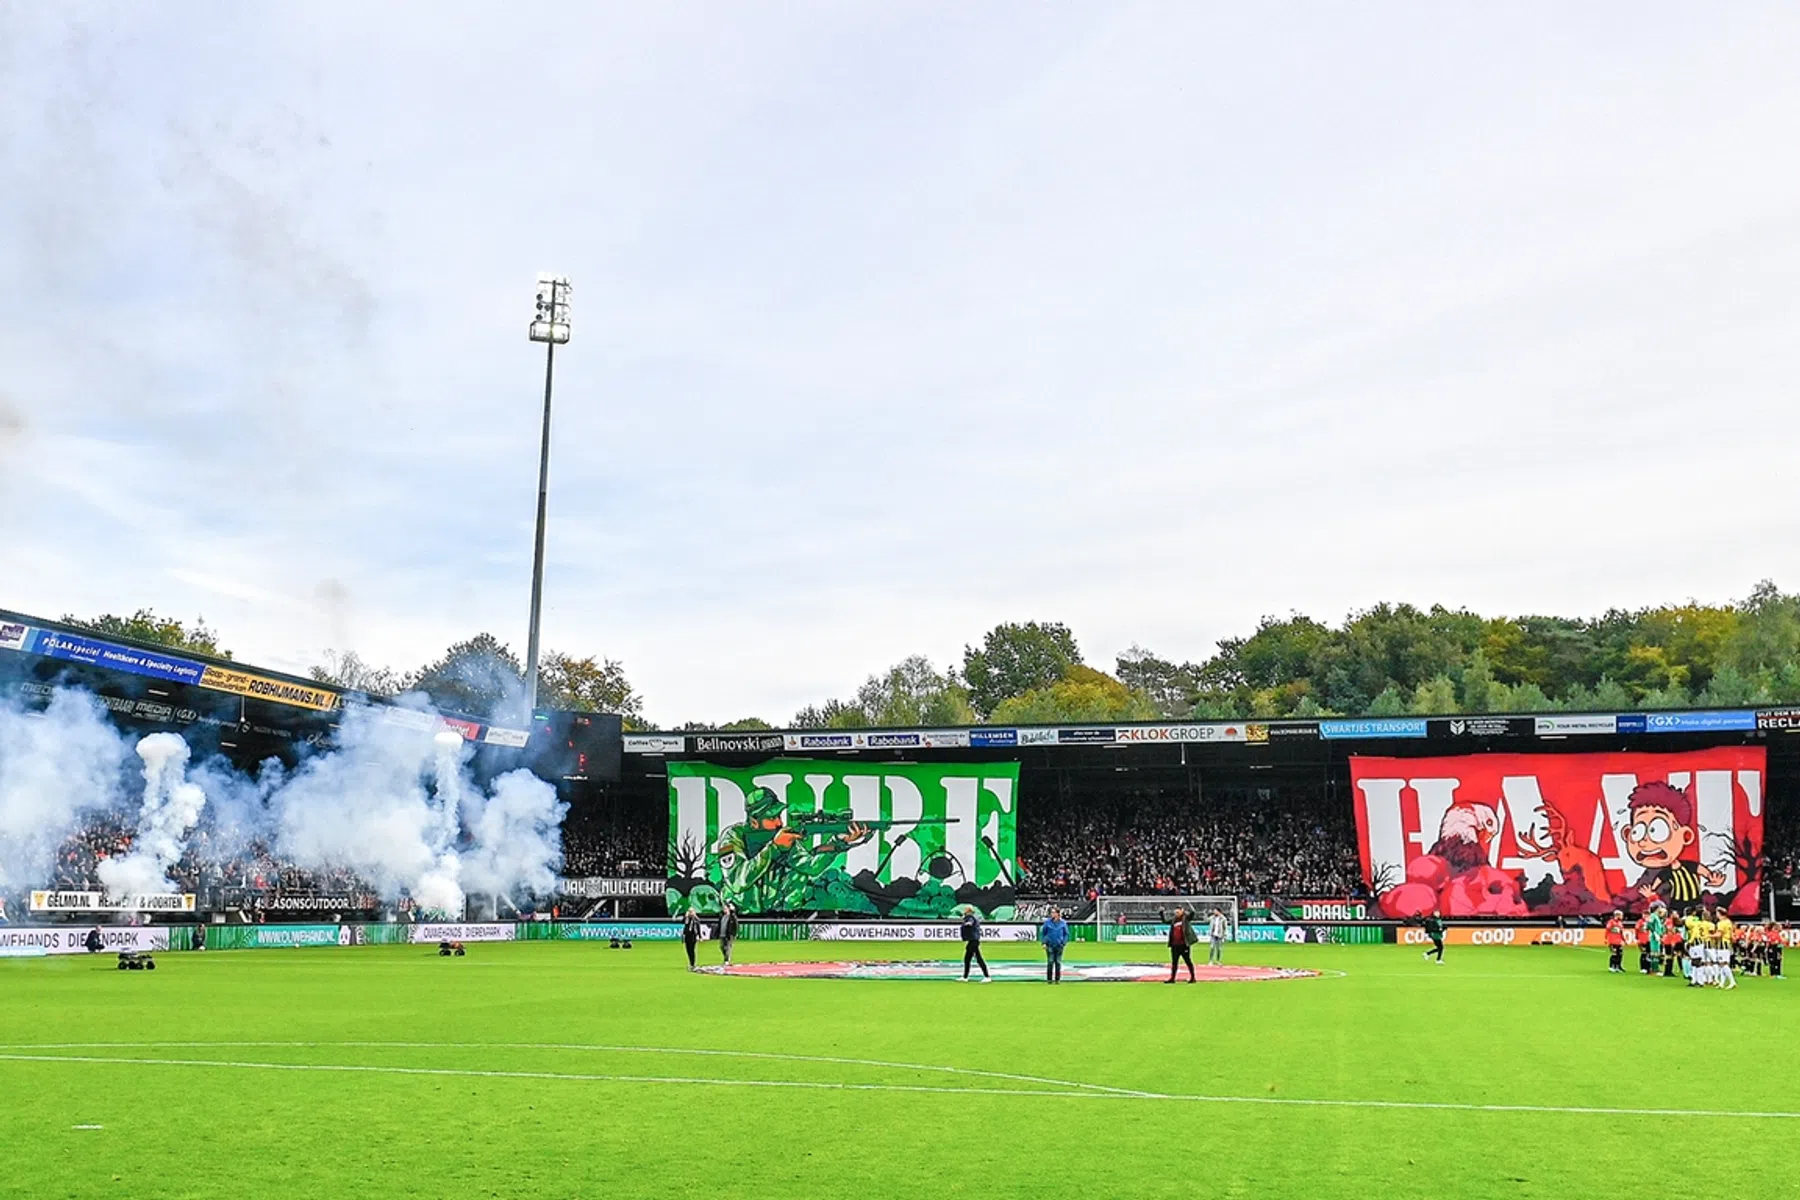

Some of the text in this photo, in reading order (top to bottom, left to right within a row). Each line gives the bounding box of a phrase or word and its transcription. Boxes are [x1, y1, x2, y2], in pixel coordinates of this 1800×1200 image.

[1372, 721, 1424, 733] TRANSPORT
[1758, 718, 1800, 729] RECL
[697, 736, 760, 750] Bellnovski
[803, 737, 850, 747] Rabobank
[870, 735, 917, 746] Rabobank
[47, 892, 91, 908] GELMO.NL
[1302, 905, 1350, 920] DRAAG
[423, 927, 500, 938] OUWEHANDS DIERENPARK
[580, 926, 685, 938] WWW.OUWEHAND.N
[839, 927, 1000, 939] OUWEHANDS DIEREARK
[1404, 928, 1447, 944] co
[1472, 928, 1514, 945] coop
[1541, 928, 1585, 944] coop
[68, 932, 138, 948] DIENPARK
